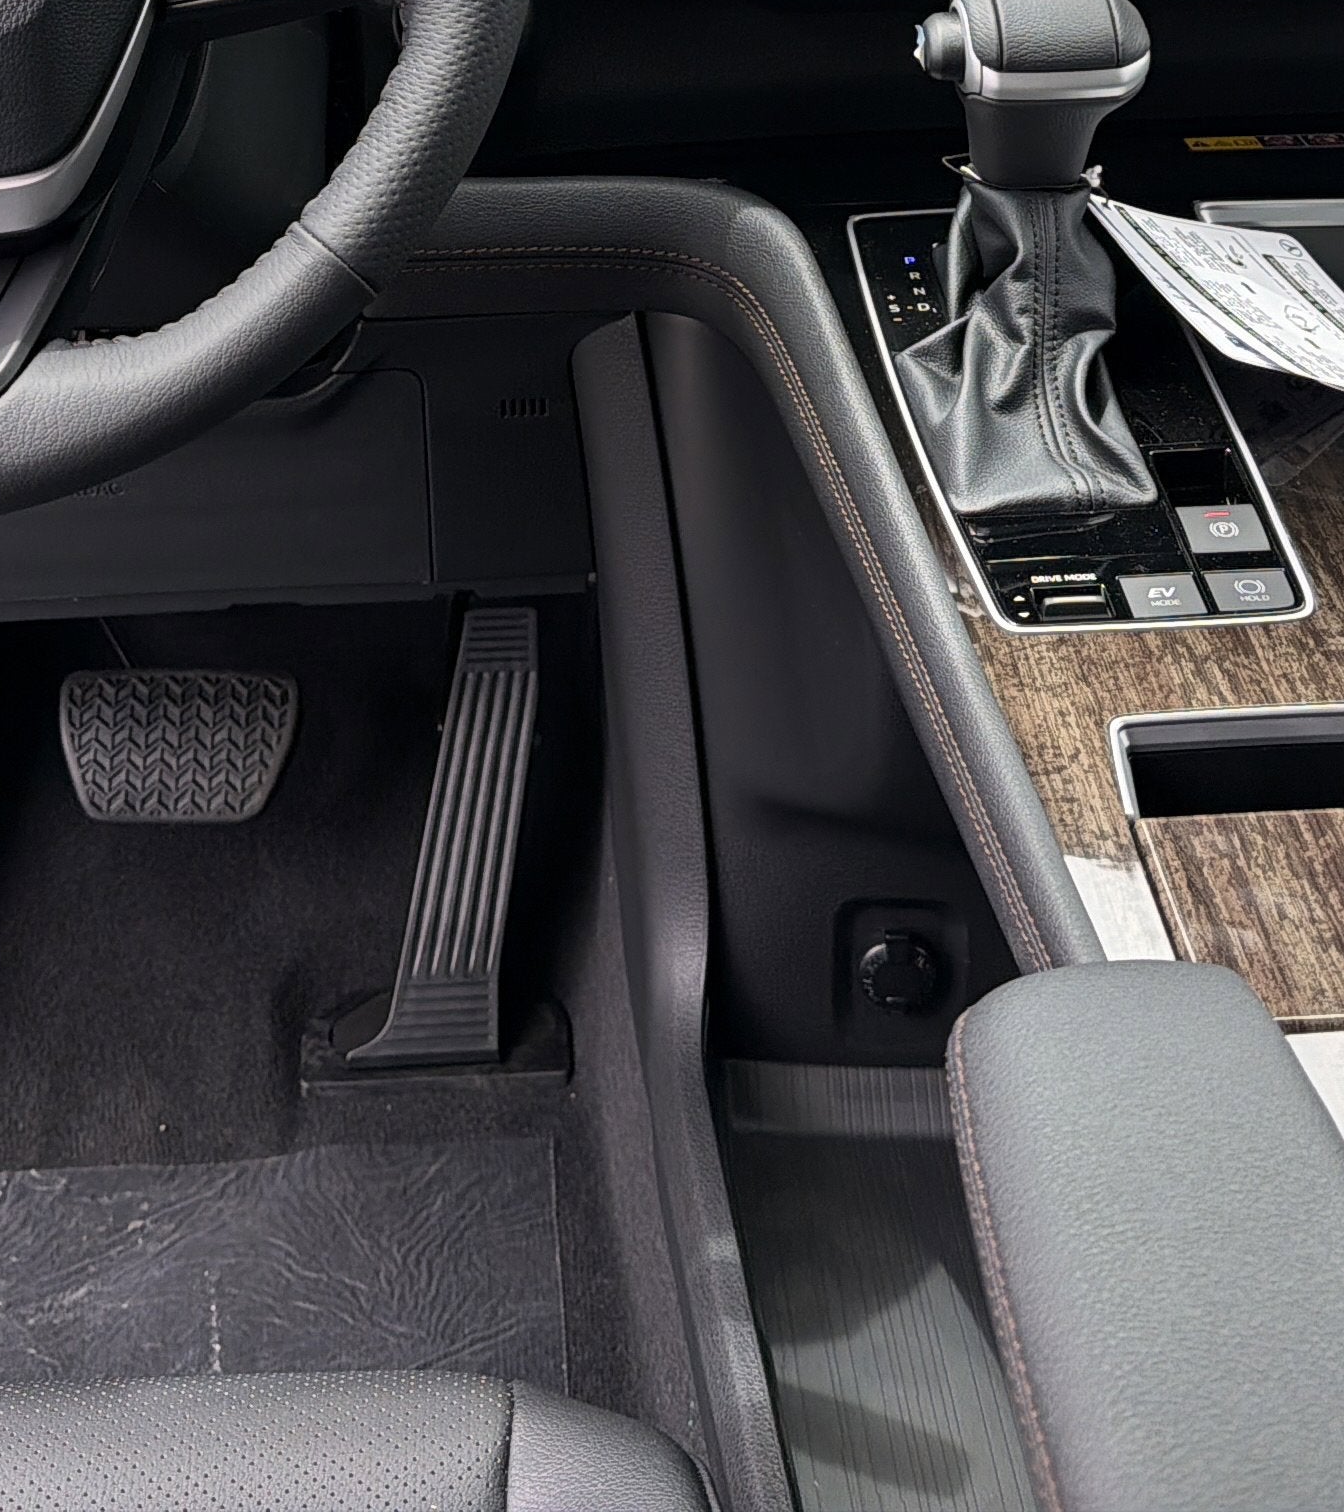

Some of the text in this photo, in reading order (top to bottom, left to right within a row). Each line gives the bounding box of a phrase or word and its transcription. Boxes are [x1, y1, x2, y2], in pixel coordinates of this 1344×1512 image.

[904, 256, 916, 265] P
[909, 271, 921, 280] R
[913, 287, 926, 296] N
[889, 303, 930, 313] S D
[1030, 573, 1097, 584] DRIVE MODE
[1148, 587, 1176, 598] EV
[1240, 594, 1270, 602] HOLD
